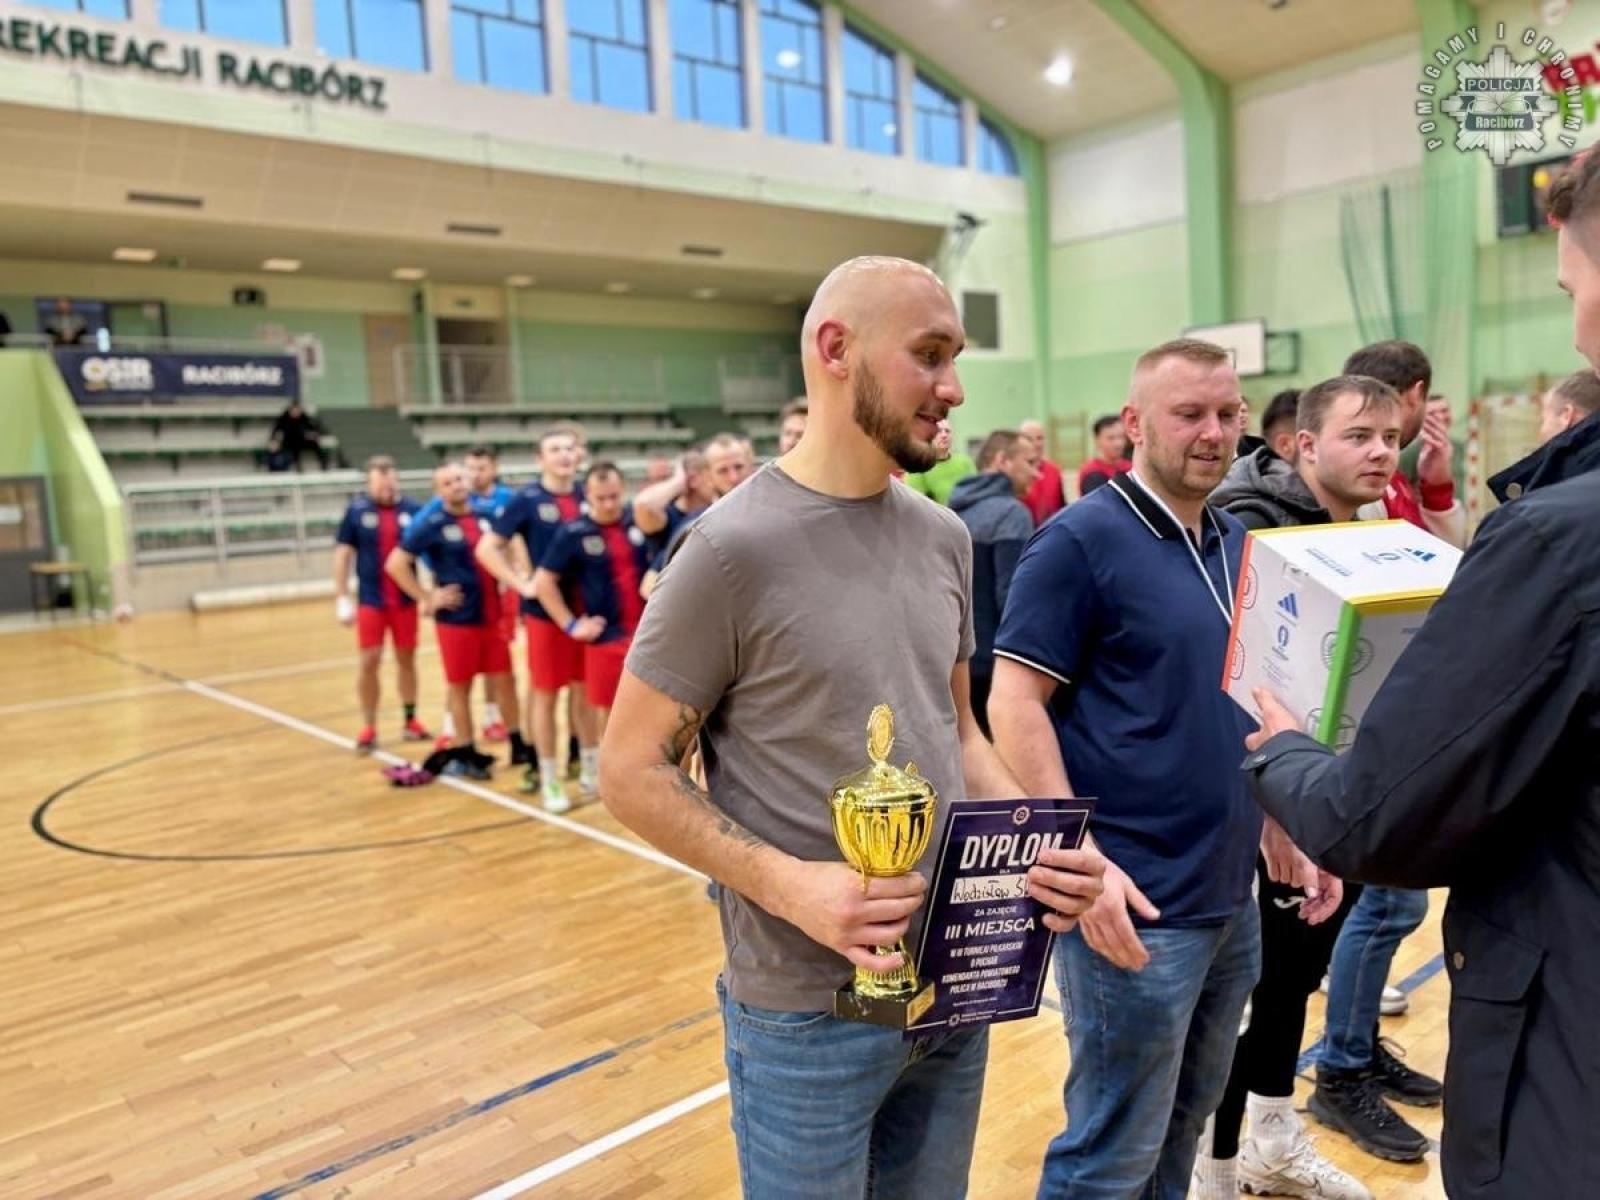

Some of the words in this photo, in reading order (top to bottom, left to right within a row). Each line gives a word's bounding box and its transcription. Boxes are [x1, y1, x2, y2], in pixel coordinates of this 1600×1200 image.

[0, 18, 200, 77] EKREACJI
[217, 51, 388, 108] RACIBÓRZ
[944, 924, 962, 940] III
[965, 917, 1036, 938] MIEJSCA
